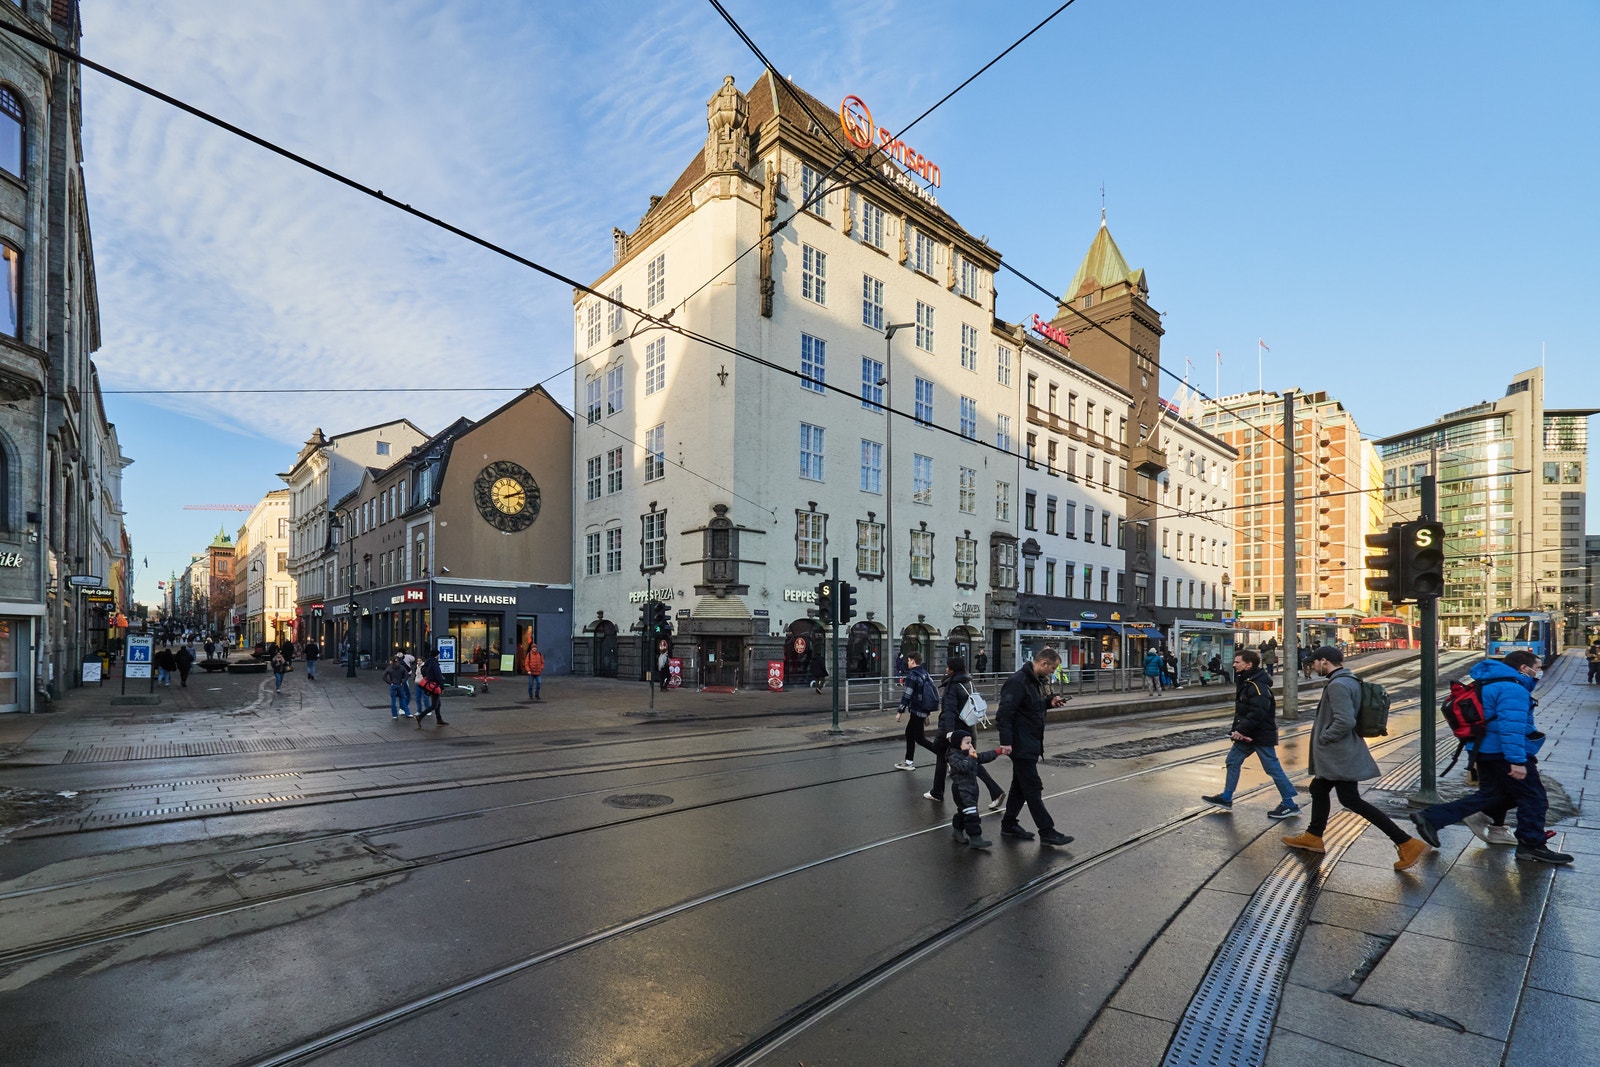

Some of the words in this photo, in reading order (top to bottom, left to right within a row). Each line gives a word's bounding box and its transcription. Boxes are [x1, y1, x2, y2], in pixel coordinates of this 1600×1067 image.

[1032, 313, 1071, 349] Scandic
[1415, 528, 1432, 547] S
[407, 590, 423, 600] HH
[628, 590, 654, 603] PEPPES
[654, 587, 674, 601] PIZZA
[822, 585, 831, 596] S
[438, 592, 472, 603] HELLY
[475, 594, 517, 605] HANSEN
[314, 609, 322, 617] N
